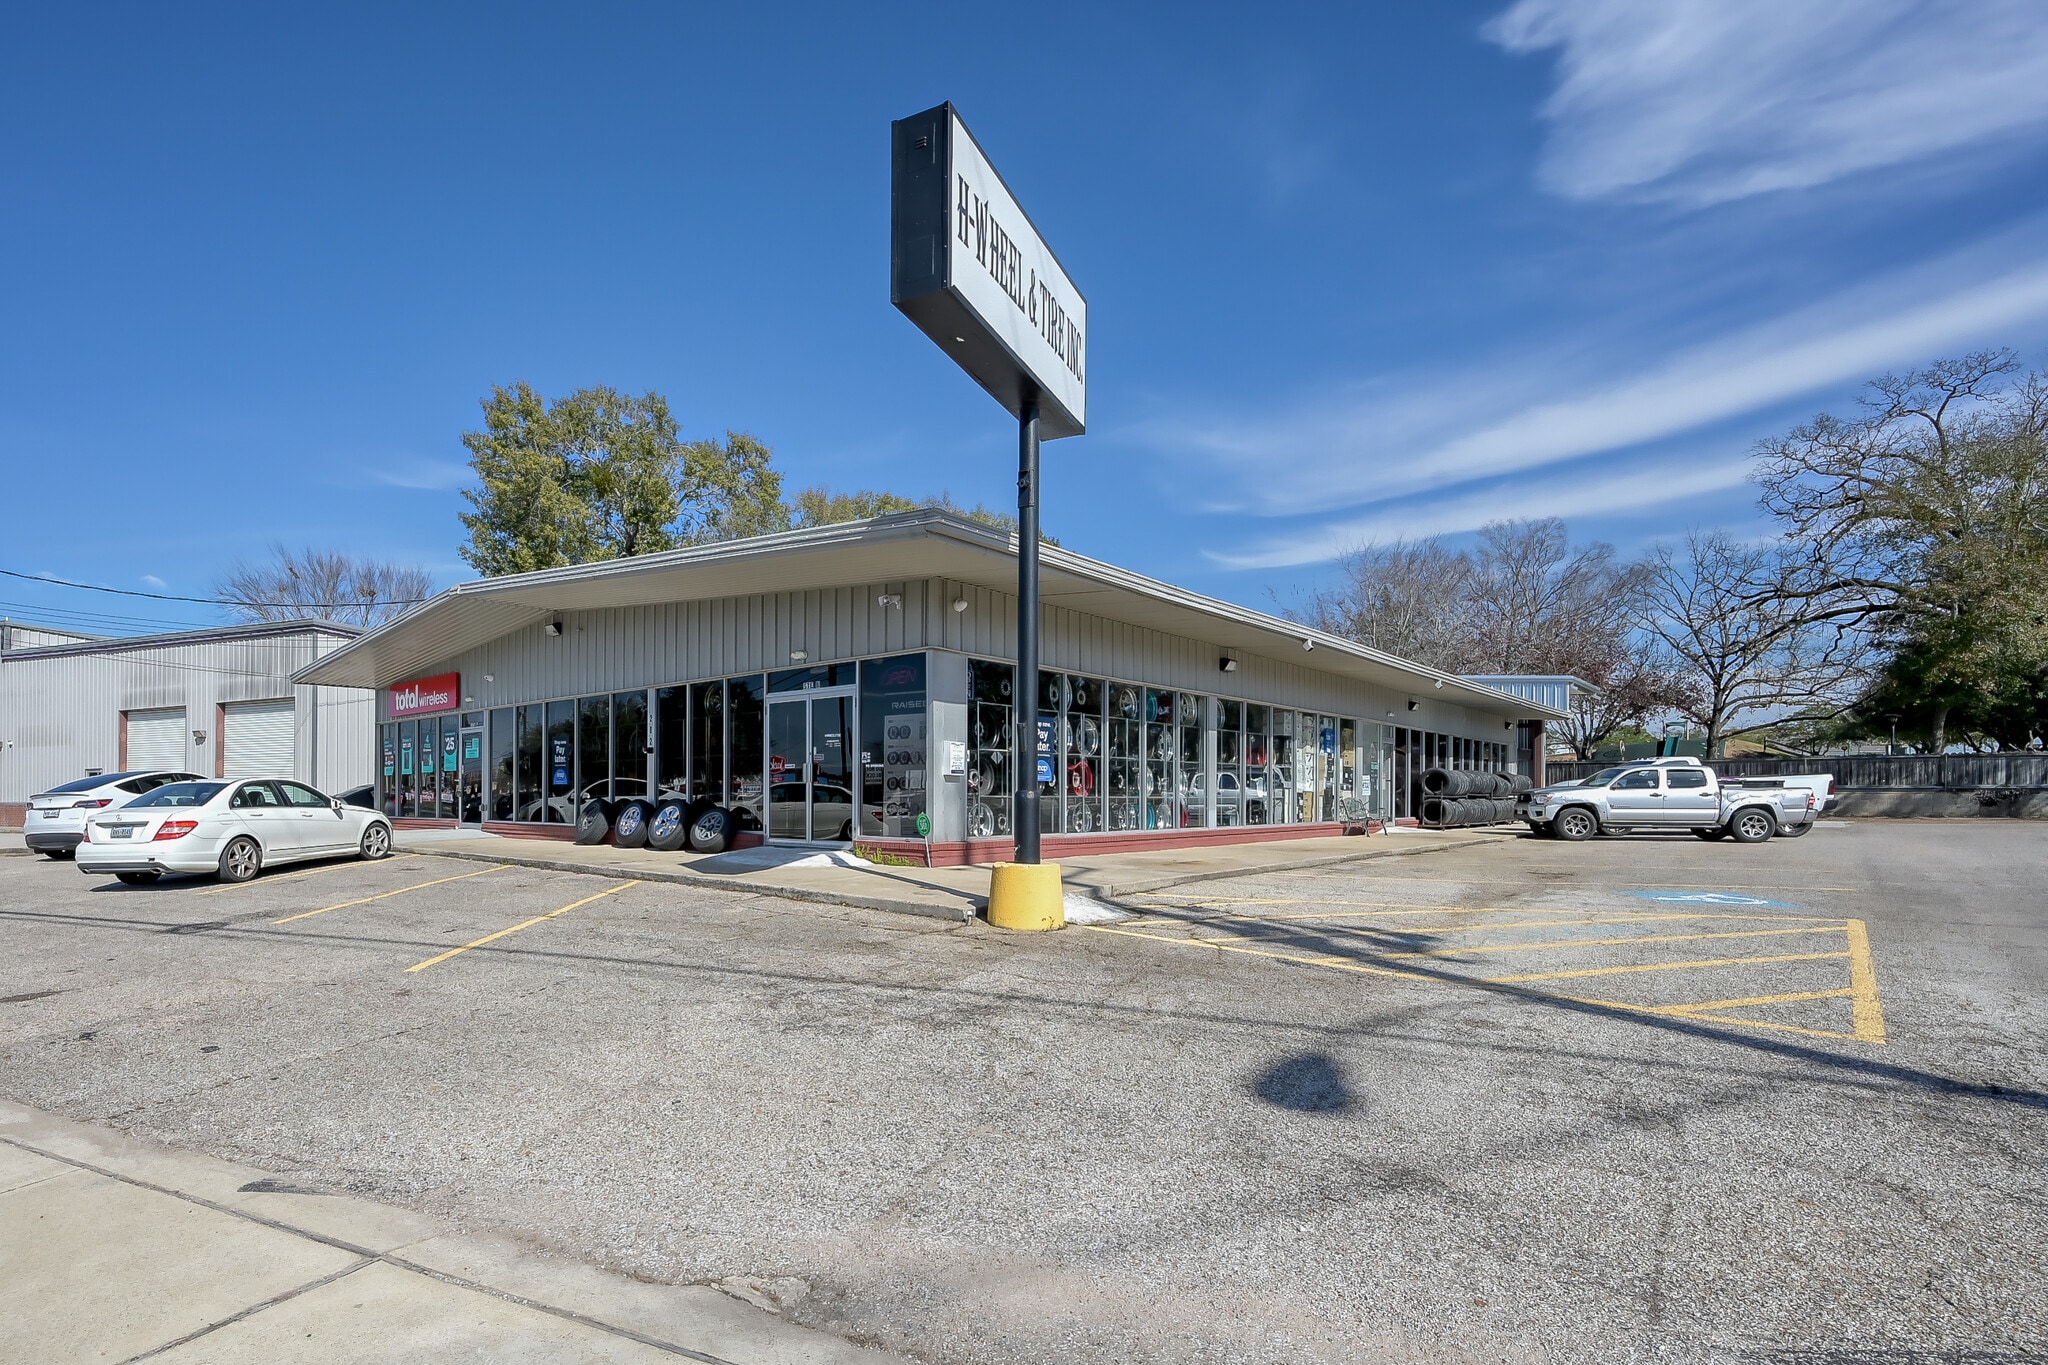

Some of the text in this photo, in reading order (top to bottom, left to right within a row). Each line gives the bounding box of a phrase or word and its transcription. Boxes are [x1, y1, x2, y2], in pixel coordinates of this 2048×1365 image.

[1028, 267, 1037, 328] &
[1039, 279, 1064, 362] TIRE
[396, 684, 448, 710] total wireless
[555, 745, 565, 755] Pay
[1037, 740, 1051, 751] ter.
